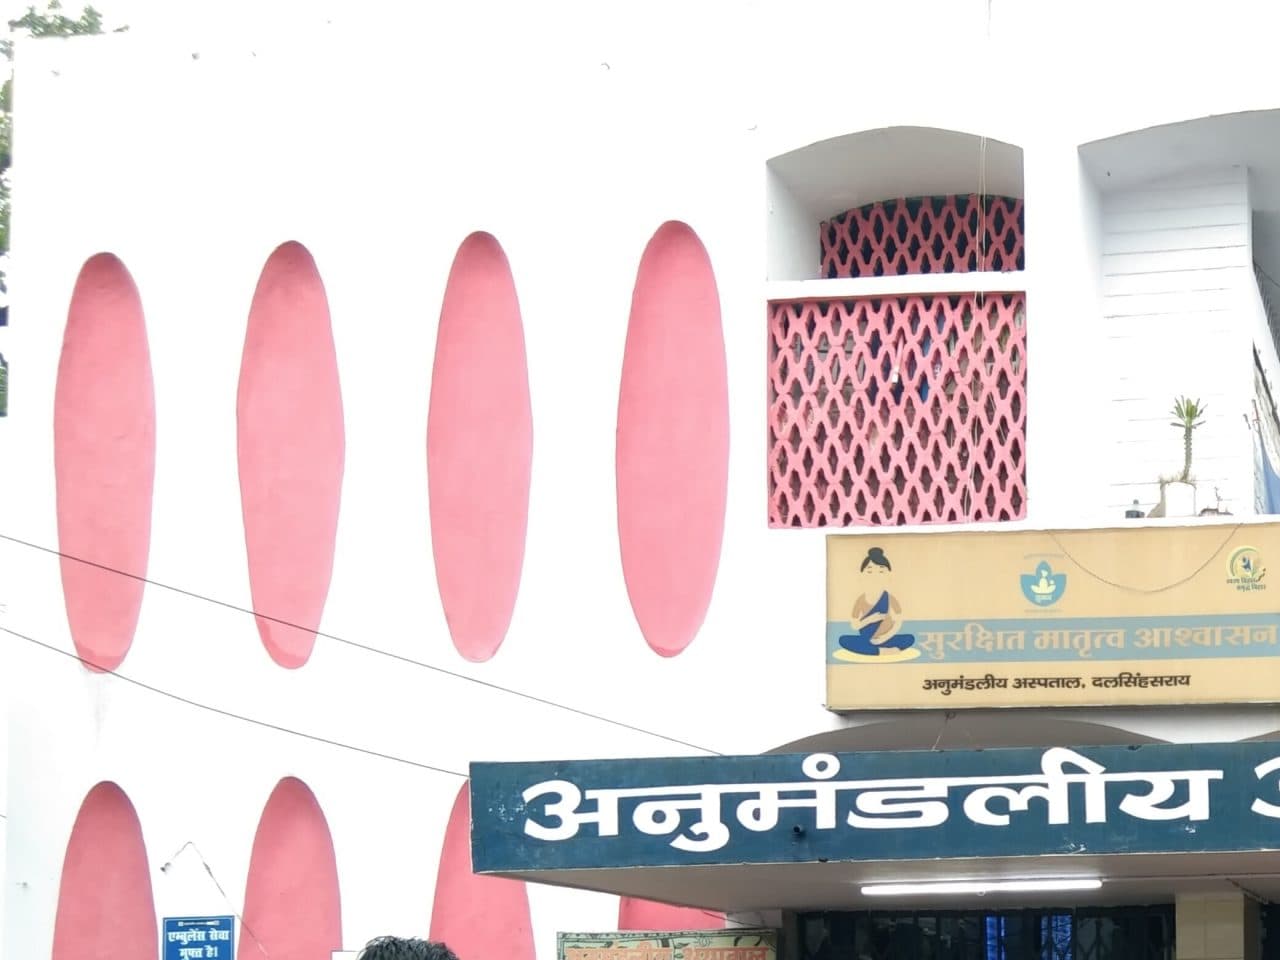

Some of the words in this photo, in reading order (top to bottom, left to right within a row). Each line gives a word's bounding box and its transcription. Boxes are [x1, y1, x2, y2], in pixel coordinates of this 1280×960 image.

[919, 622, 1025, 659] सुरक्षित
[1034, 627, 1125, 657] मातृत्व
[1134, 623, 1278, 648] आश्वासन
[922, 673, 1009, 695] अनुमंडलीय
[1092, 672, 1191, 690] दलसिंहसराय
[521, 746, 1223, 852] अनुमंडलीय
[208, 927, 230, 941] सेवा
